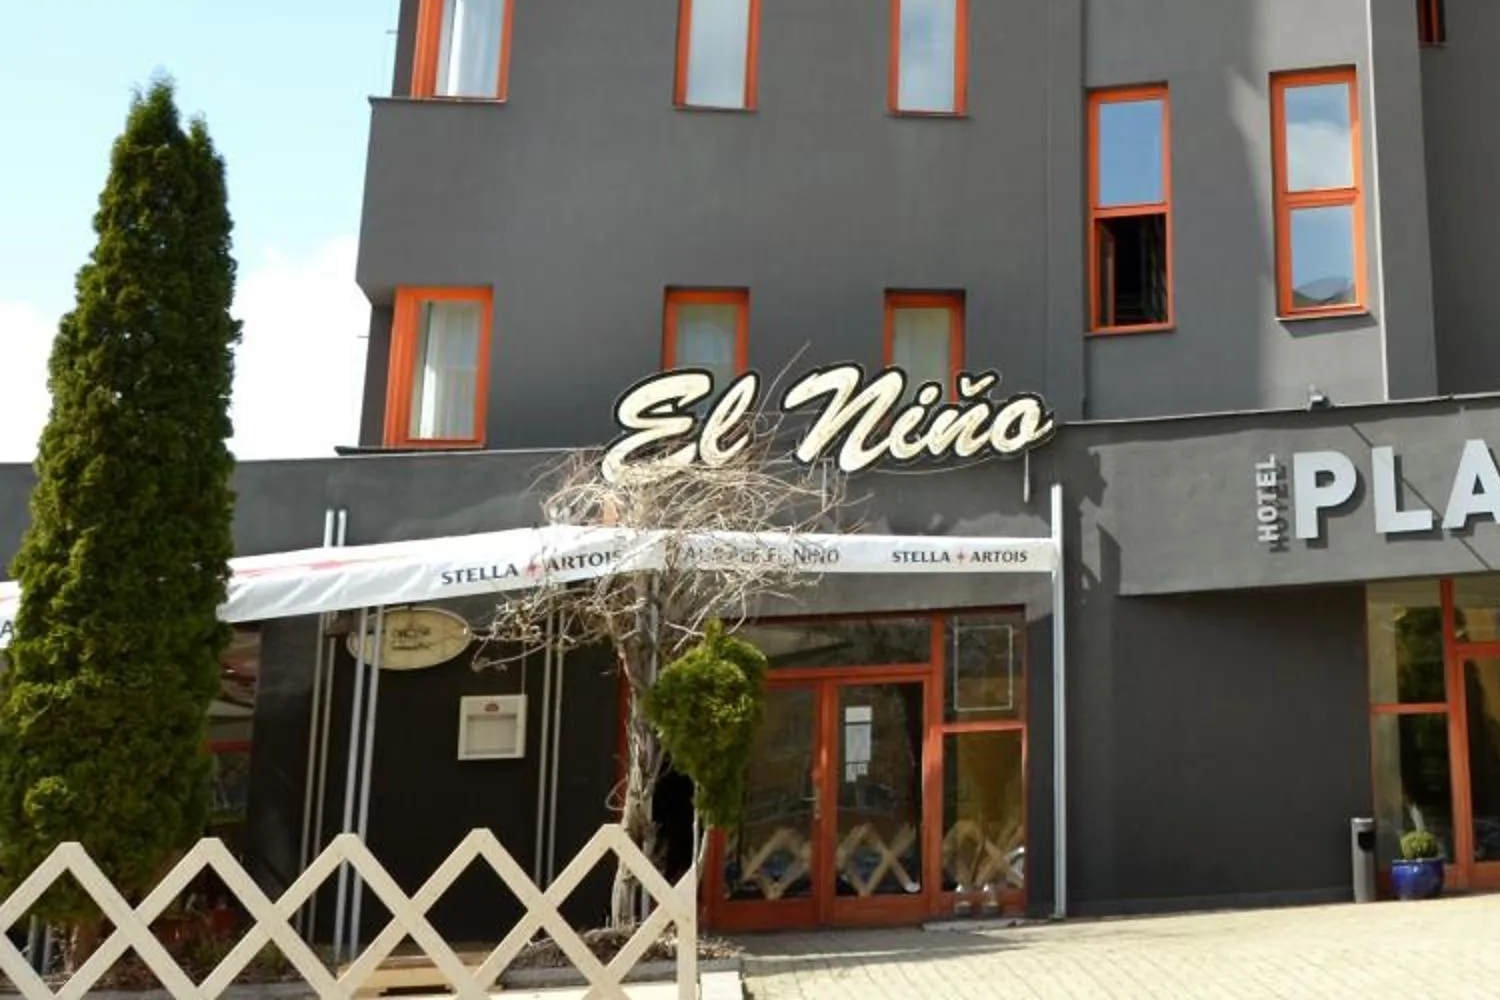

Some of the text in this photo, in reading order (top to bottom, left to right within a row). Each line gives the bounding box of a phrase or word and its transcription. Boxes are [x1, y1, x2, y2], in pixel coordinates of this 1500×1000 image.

[601, 368, 760, 485] El
[1254, 453, 1280, 542] HOTEL
[441, 563, 519, 586] STELLA
[892, 551, 1029, 563] STELLA ARTOIS
